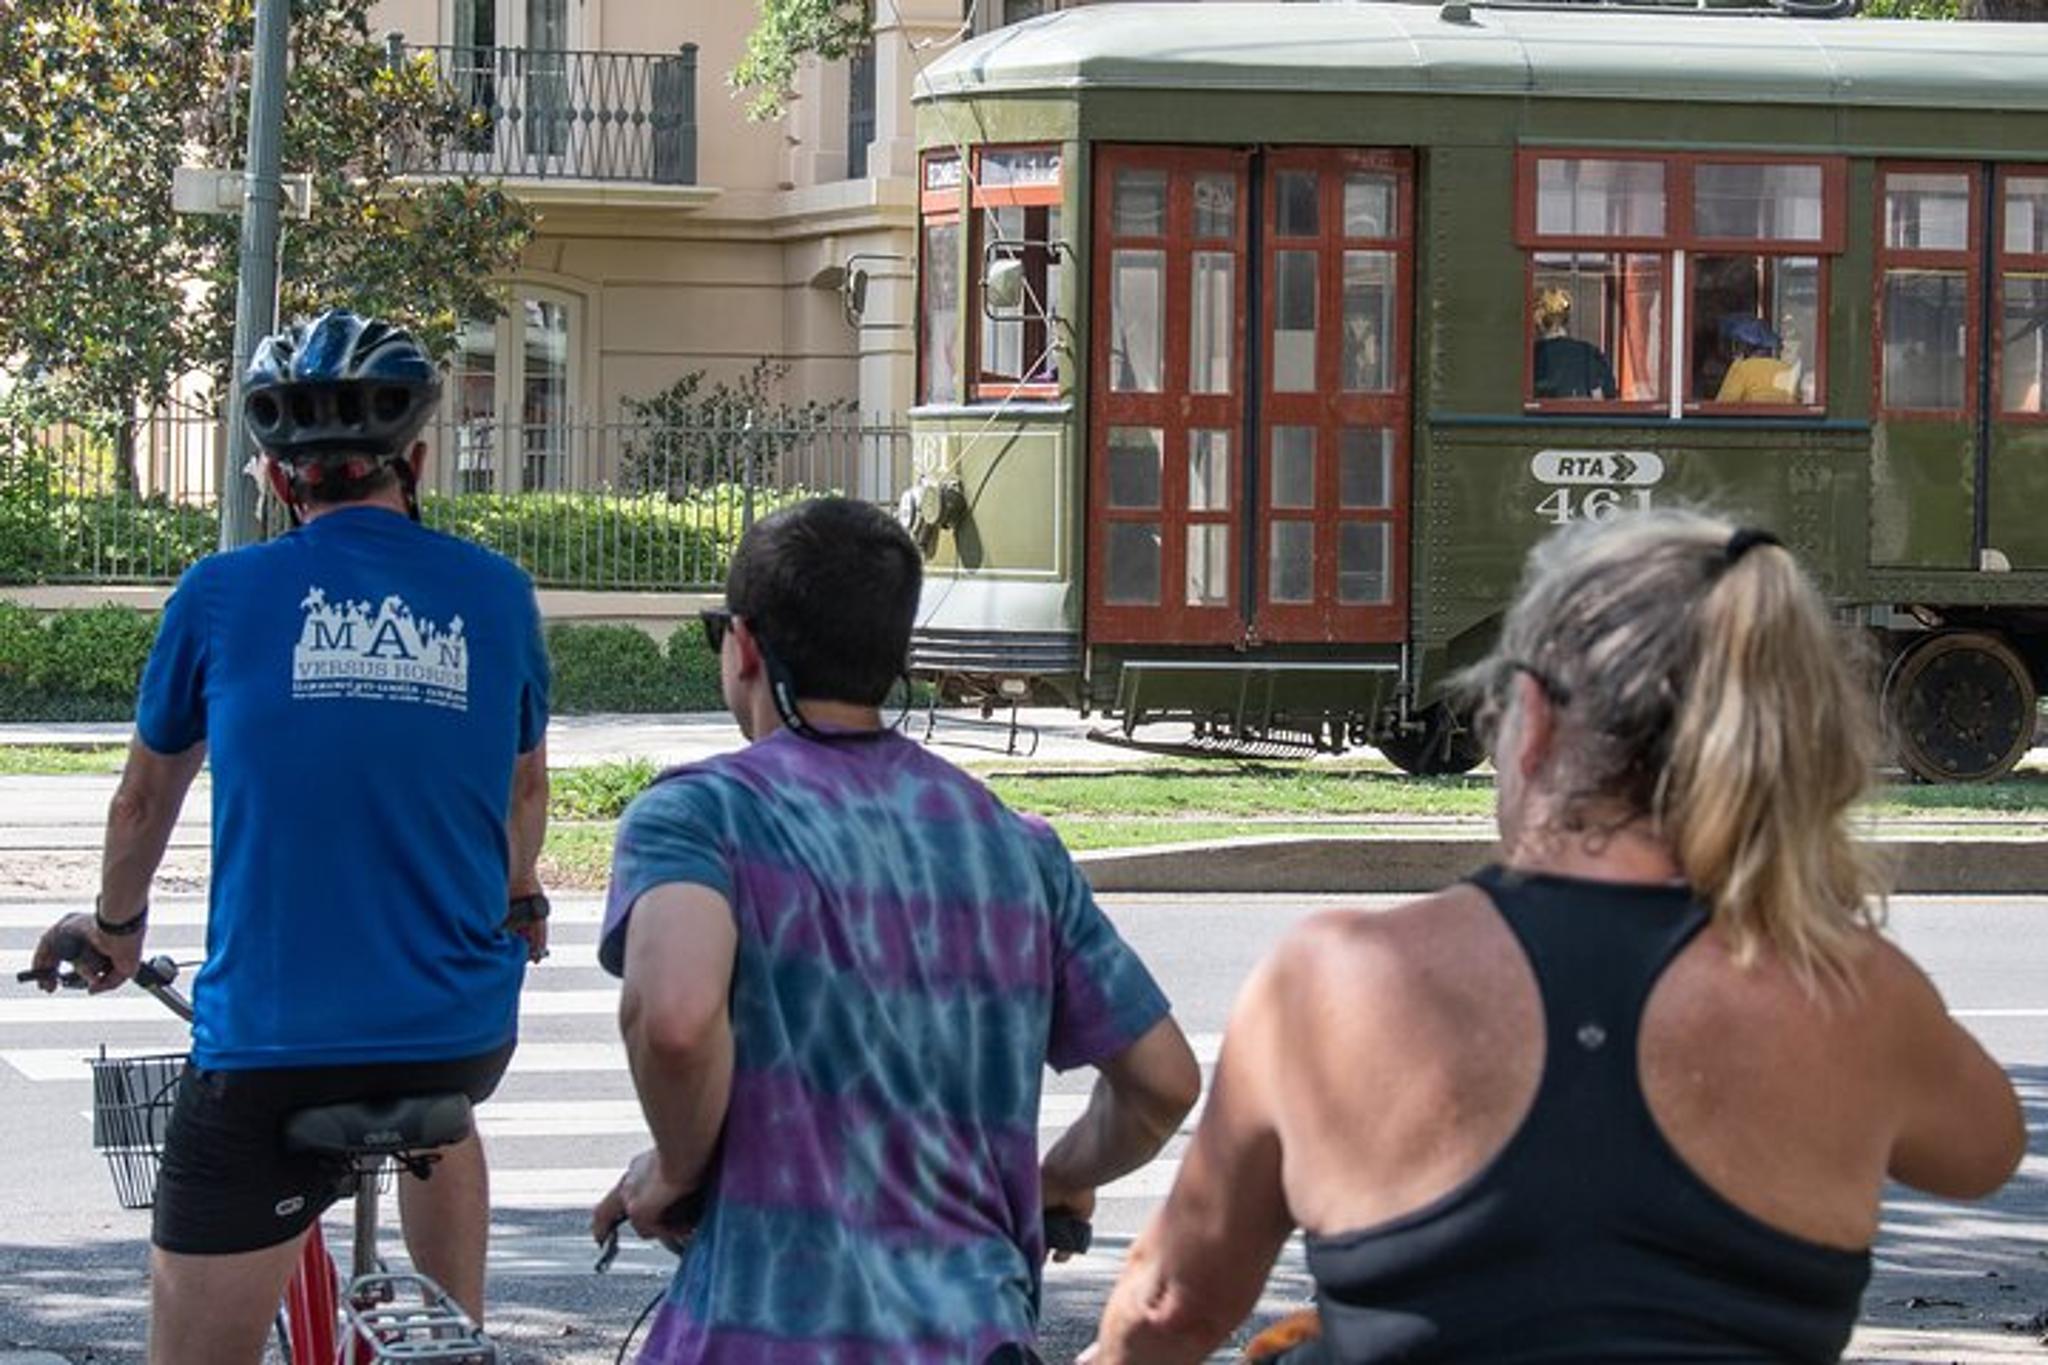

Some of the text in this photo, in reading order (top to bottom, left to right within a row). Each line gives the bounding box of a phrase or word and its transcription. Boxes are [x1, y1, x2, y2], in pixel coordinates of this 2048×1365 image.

[1557, 457, 1605, 476] RTA
[309, 619, 461, 669] MAN
[299, 659, 388, 678] VERSUS
